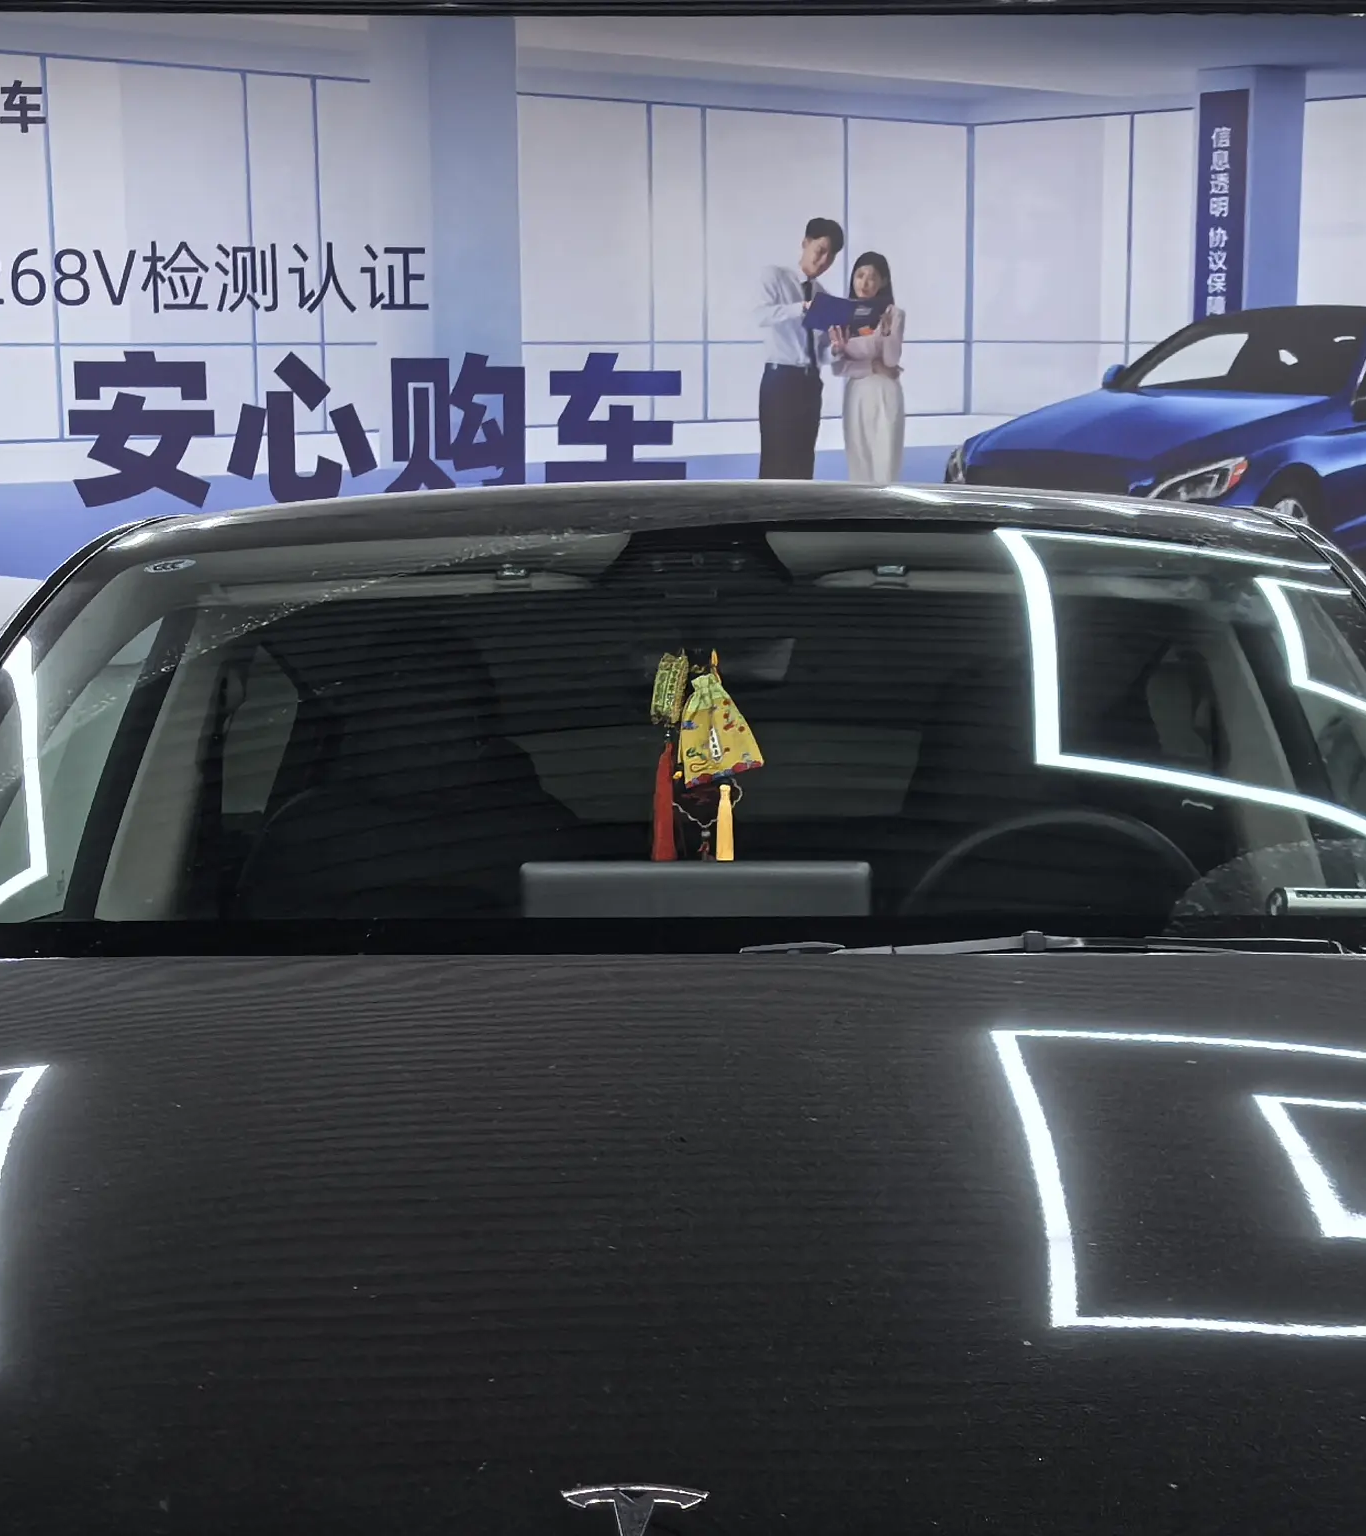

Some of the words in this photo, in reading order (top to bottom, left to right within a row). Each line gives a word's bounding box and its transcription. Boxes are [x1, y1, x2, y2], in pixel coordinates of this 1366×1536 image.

[1208, 126, 1232, 218] 信息透明
[68, 351, 688, 508] 安心购车
